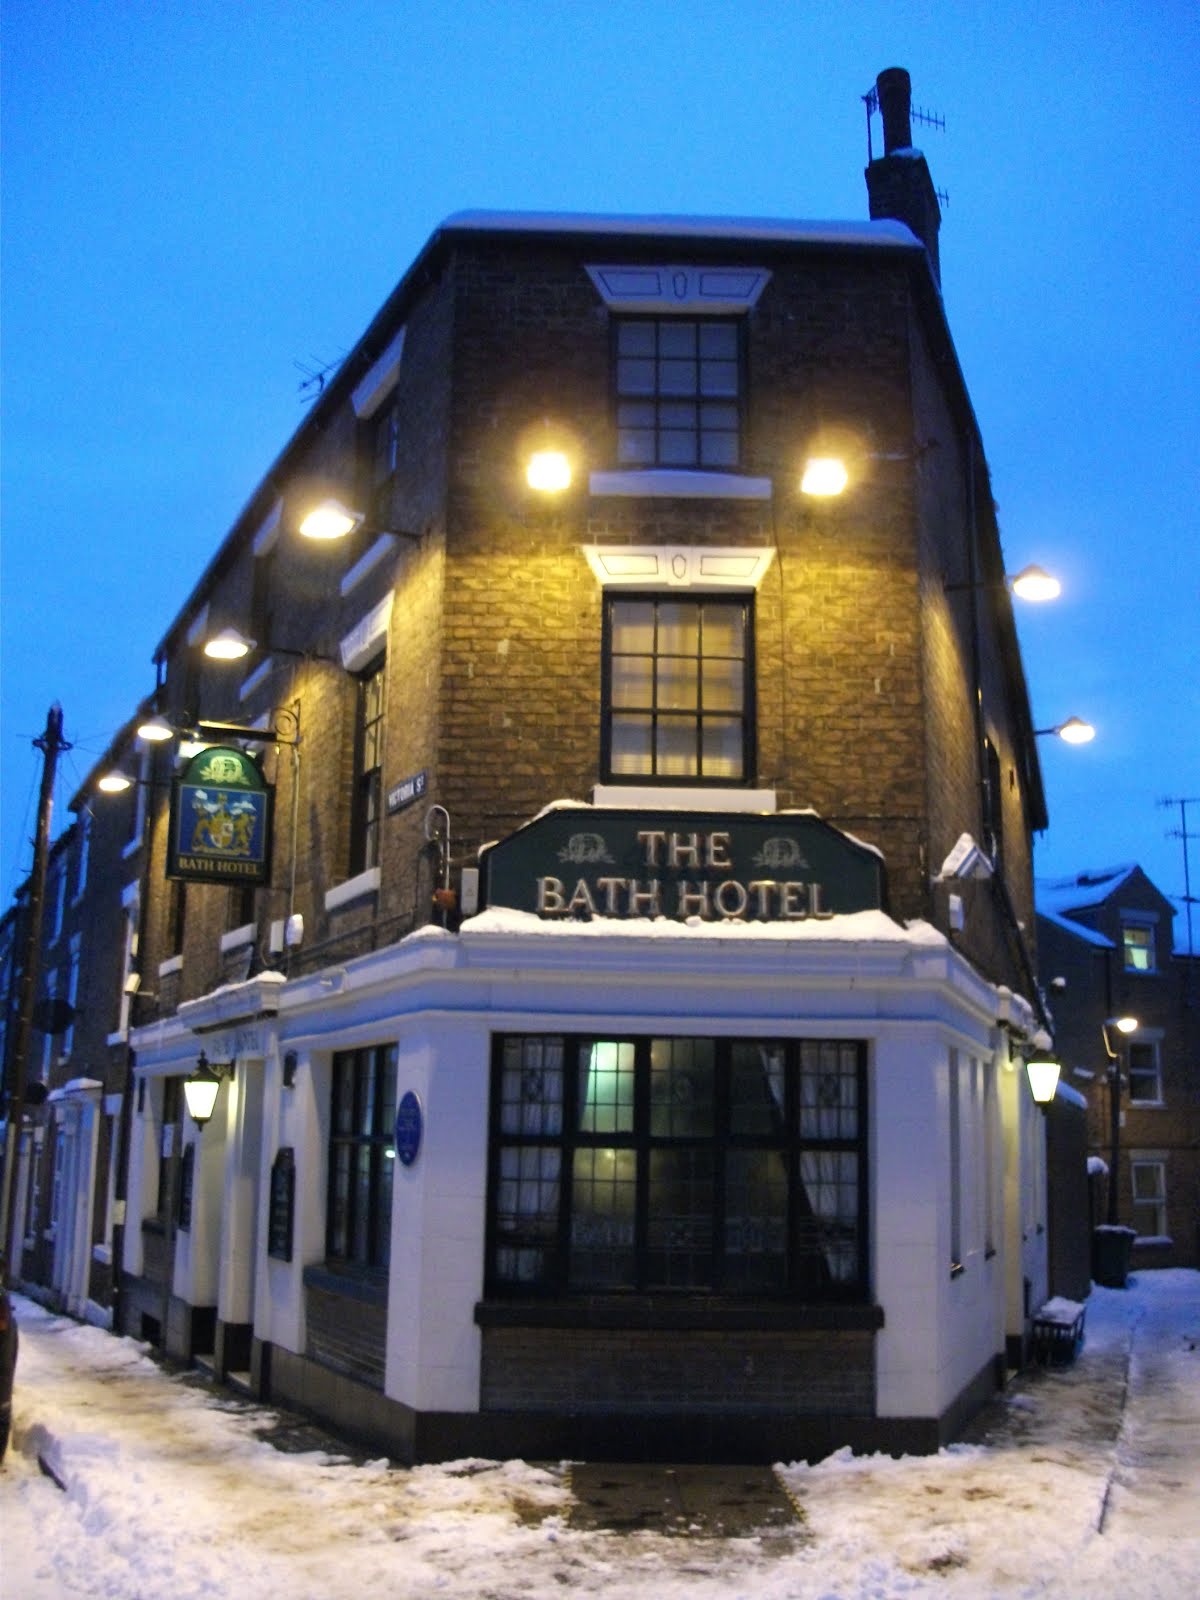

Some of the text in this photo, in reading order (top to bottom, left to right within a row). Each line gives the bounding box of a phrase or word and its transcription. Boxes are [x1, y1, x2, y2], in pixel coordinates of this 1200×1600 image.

[178, 856, 258, 876] BATH HOTEL
[637, 830, 733, 867] THE
[536, 876, 834, 918] BATH HOTEL
